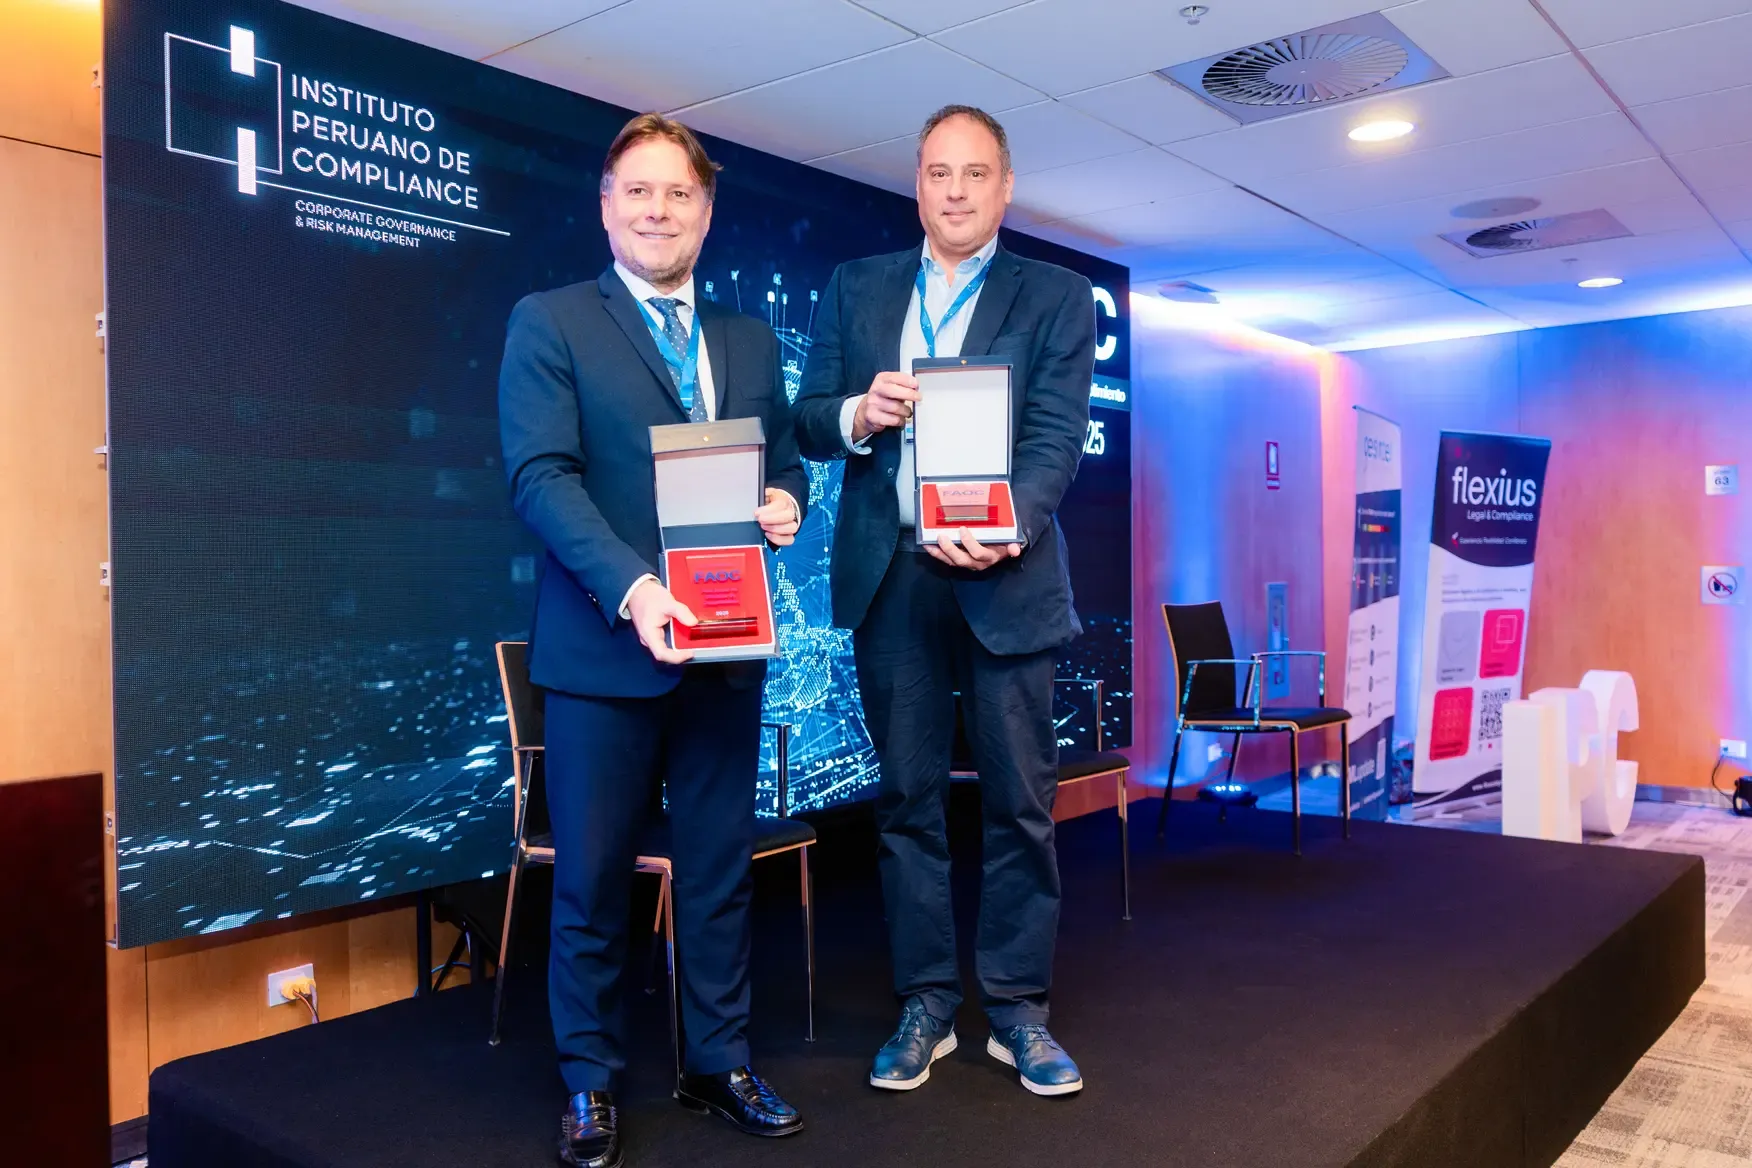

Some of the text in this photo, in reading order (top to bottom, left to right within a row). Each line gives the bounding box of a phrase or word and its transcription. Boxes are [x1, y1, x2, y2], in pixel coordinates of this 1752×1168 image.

[292, 73, 435, 132] INSTITUTO
[292, 110, 470, 175] PERUANO DE
[292, 147, 479, 209] COMPLIANCE
[295, 199, 457, 242] CORPORATE GOVERNANCE
[295, 216, 421, 248] & RISK MANAGEMENT
[1083, 419, 1105, 455] 25
[1451, 465, 1537, 507] flexius
[1467, 509, 1486, 522] Legal
[1491, 509, 1534, 522] Compliance
[694, 569, 741, 583] FAOC
